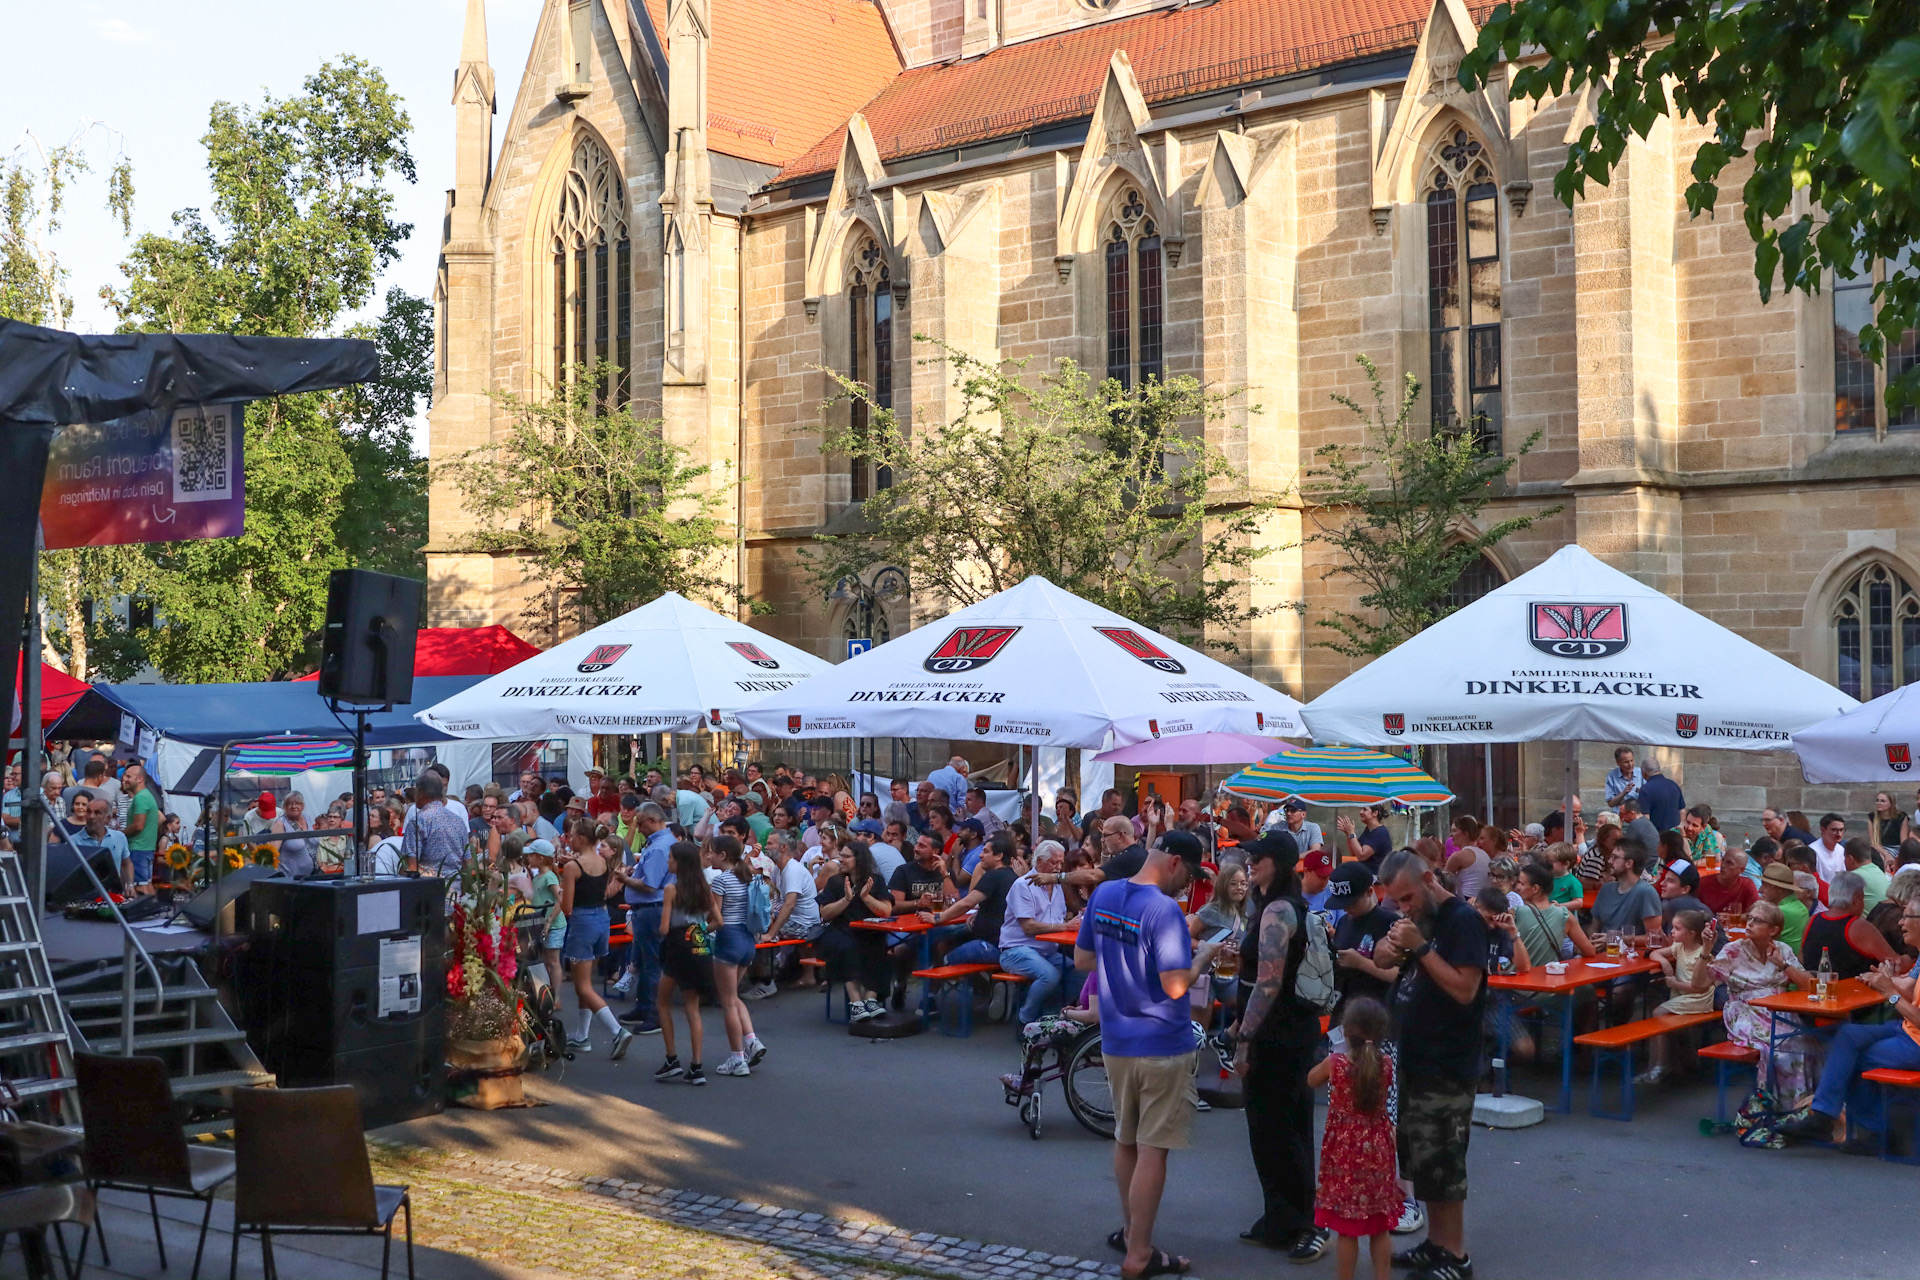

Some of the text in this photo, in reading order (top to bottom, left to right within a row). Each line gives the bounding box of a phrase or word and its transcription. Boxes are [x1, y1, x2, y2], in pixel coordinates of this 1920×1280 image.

[852, 643, 864, 658] P
[1552, 642, 1607, 655] CD
[582, 664, 603, 672] CD
[933, 659, 973, 670] CD
[1154, 659, 1181, 671] CD
[1511, 670, 1653, 679] FAMILIENBRAUEREI
[500, 685, 643, 697] DINKELACKER
[1465, 680, 1704, 699] DINKELACKER
[847, 691, 1006, 703] DINKELACKER
[1158, 691, 1255, 703] DINKELACKER
[556, 715, 691, 725] VON GANZEM HERZEN HIER.
[805, 721, 856, 730] DINKELACKER
[445, 723, 480, 731] NKELACKER
[994, 725, 1051, 736] DINKELACKER
[1411, 721, 1494, 732] DINKELACKER
[1704, 726, 1789, 740] DINKELACKER
